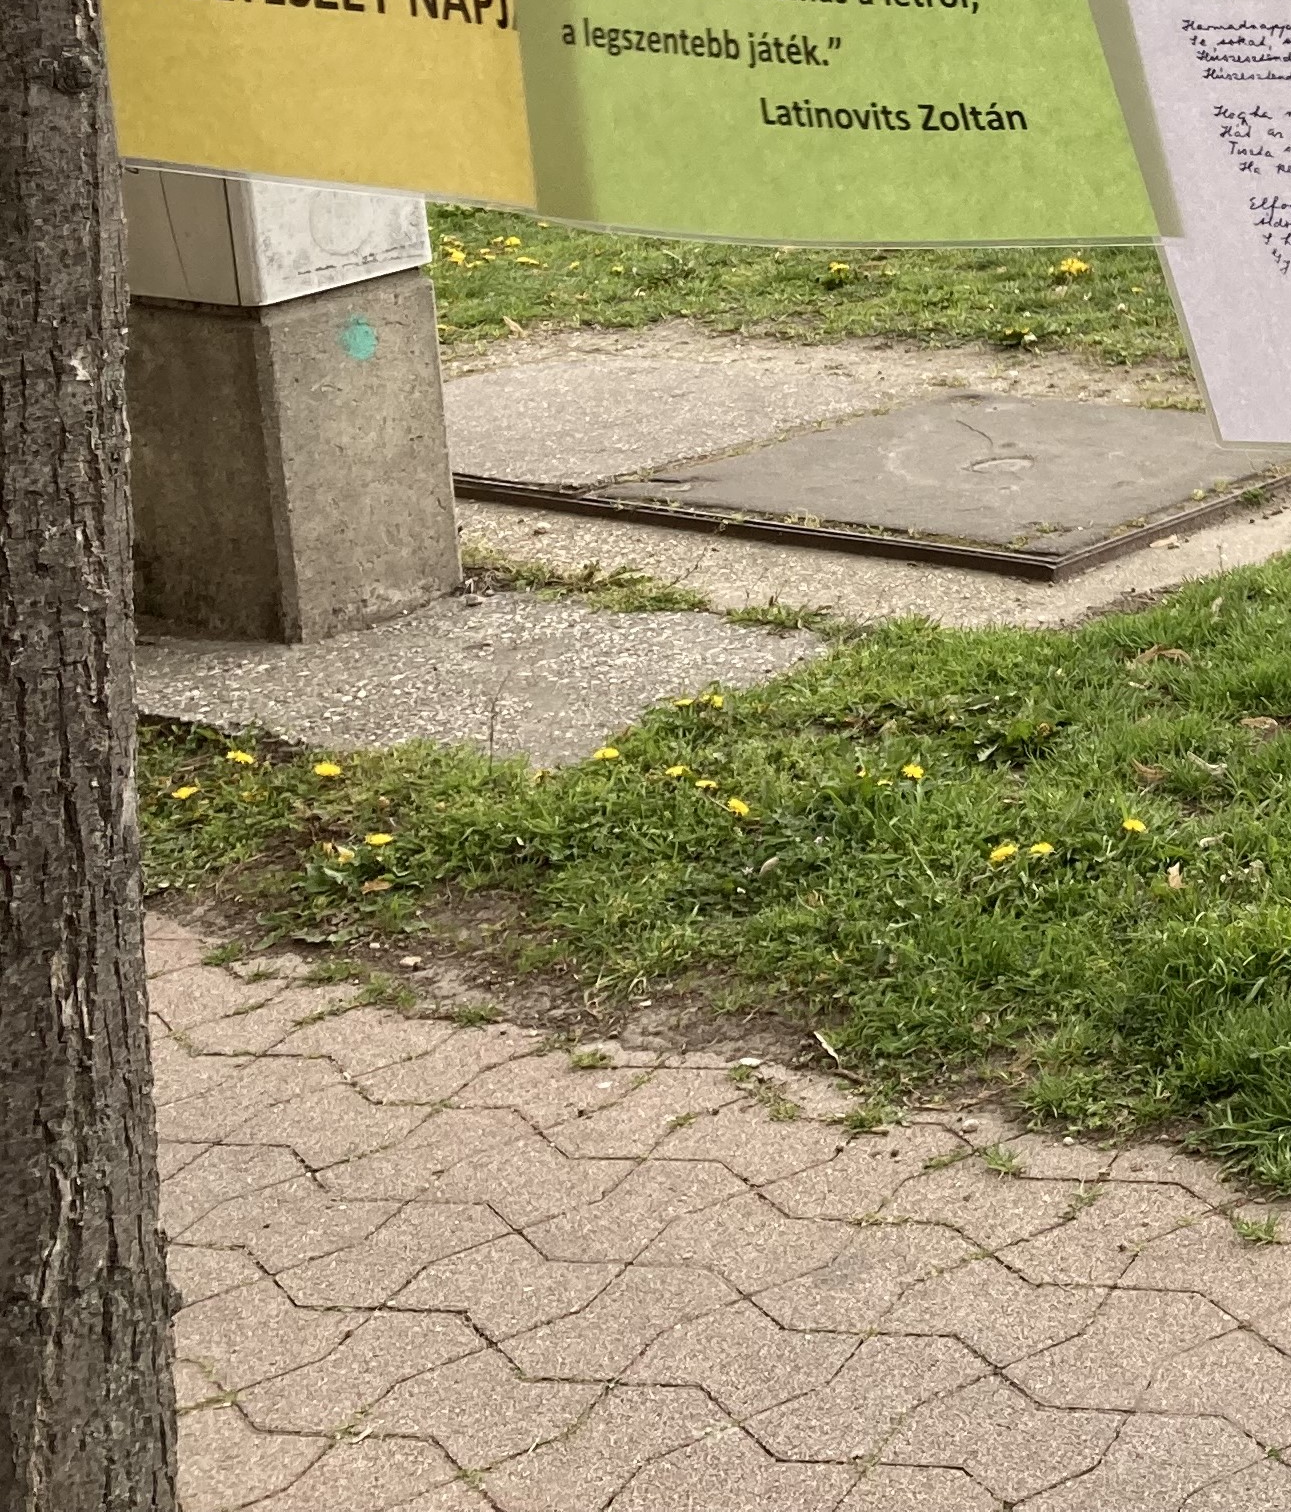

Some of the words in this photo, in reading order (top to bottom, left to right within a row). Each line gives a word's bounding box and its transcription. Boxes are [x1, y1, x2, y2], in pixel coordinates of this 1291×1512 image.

[560, 23, 577, 46] a
[582, 17, 741, 61] legszentebb
[759, 96, 912, 131] Latinovits
[916, 101, 1028, 132] Zoltán
